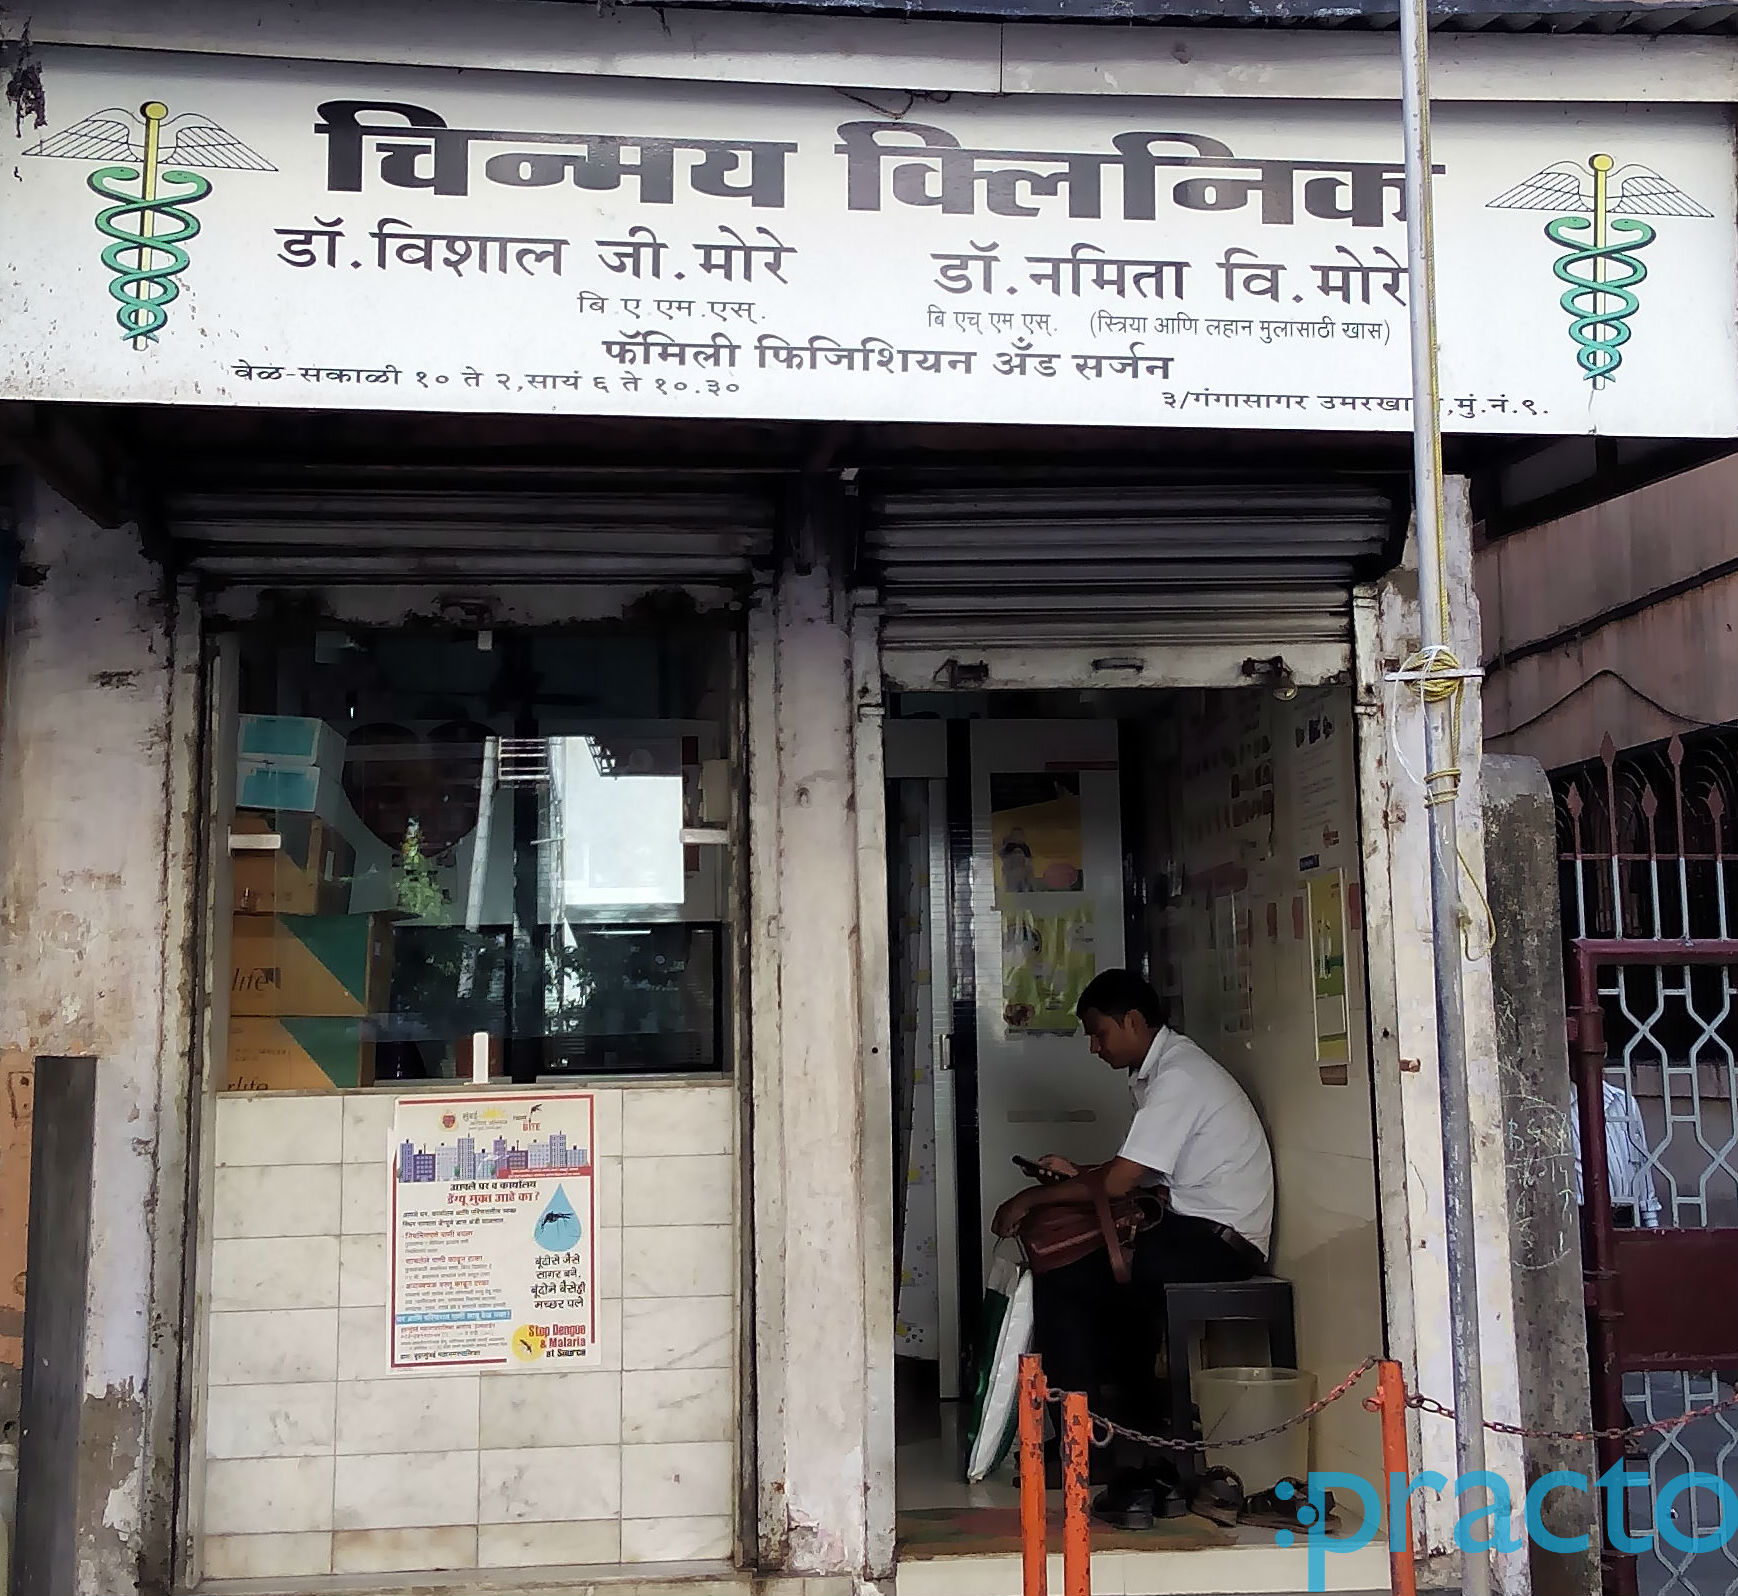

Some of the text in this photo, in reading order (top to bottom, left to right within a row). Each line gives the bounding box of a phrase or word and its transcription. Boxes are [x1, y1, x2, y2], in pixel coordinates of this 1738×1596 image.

[314, 99, 1446, 227] चिन्मय क्लिनिक
[1154, 312, 1199, 335] आणि
[1205, 317, 1253, 338] लहान
[754, 333, 977, 374] फिजिशियन
[1072, 341, 1174, 380] सर्जन
[416, 371, 449, 389] १०
[461, 366, 484, 388] ते
[593, 376, 610, 394] ६
[620, 371, 643, 392] ते
[655, 377, 740, 396] १०.३०
[528, 1324, 586, 1338] Stop Dengue
[540, 1337, 586, 1349] & Malaria
